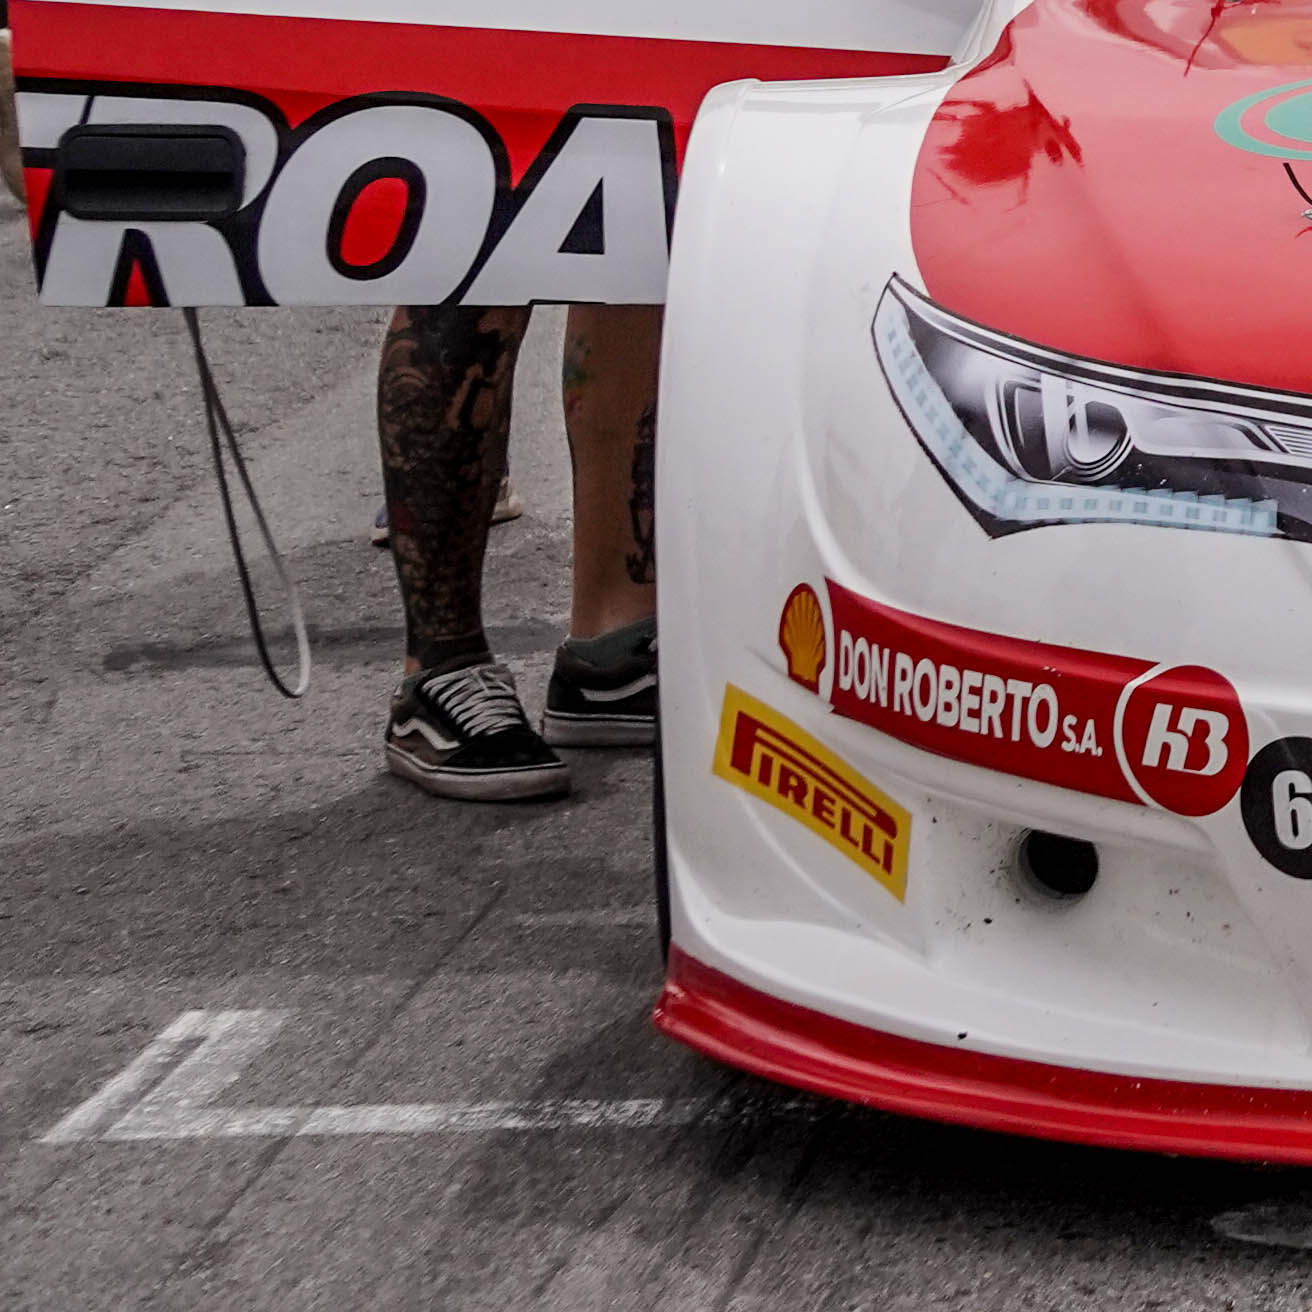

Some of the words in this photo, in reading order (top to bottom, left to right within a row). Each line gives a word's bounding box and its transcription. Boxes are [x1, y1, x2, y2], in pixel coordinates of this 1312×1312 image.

[838, 628, 889, 708] DON
[895, 651, 1058, 749] ROBERTO
[1062, 714, 1103, 758] S.A.
[730, 710, 898, 875] PIRELLI
